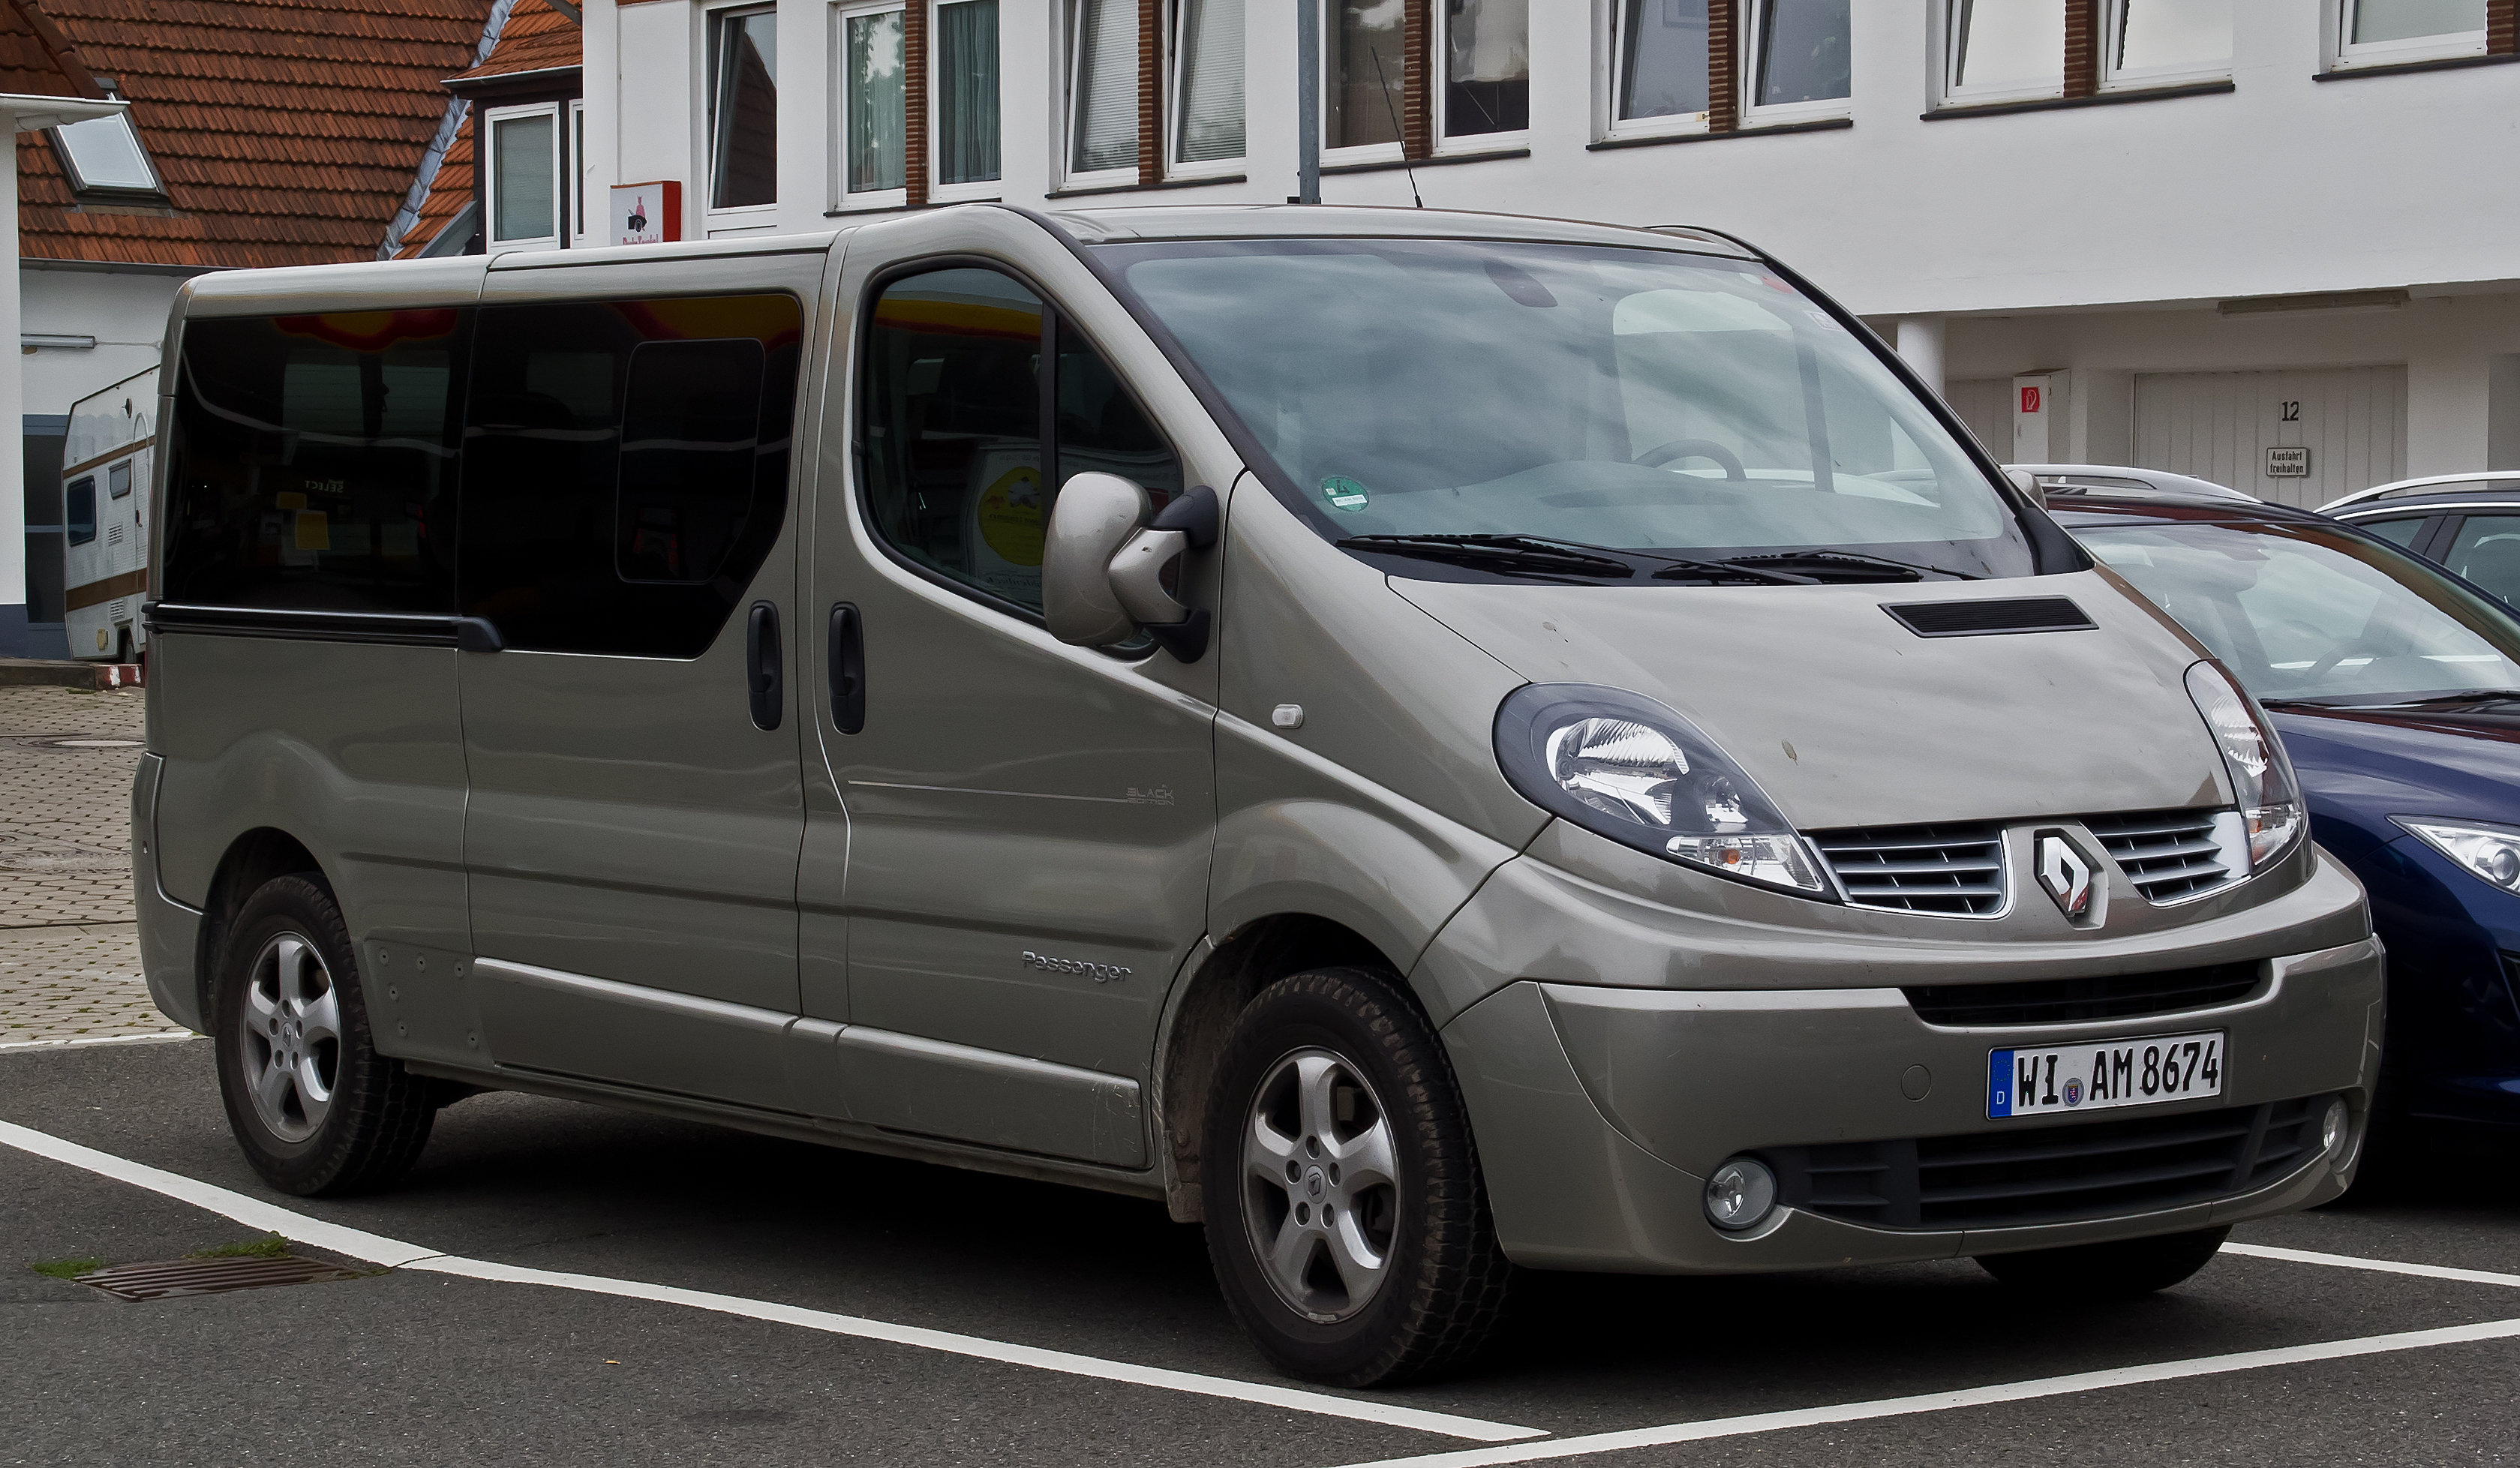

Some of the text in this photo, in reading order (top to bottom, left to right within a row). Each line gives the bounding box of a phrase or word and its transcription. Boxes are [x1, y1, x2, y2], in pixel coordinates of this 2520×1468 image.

[2281, 401, 2299, 422] 12
[2272, 451, 2302, 461] Ausfahrt
[2270, 463, 2304, 473] freihalten
[1126, 787, 1173, 799] BLACK
[1022, 950, 1132, 983] Passenger
[2017, 1039, 2219, 1107] WI AM 8674
[1996, 1091, 2005, 1105] D
